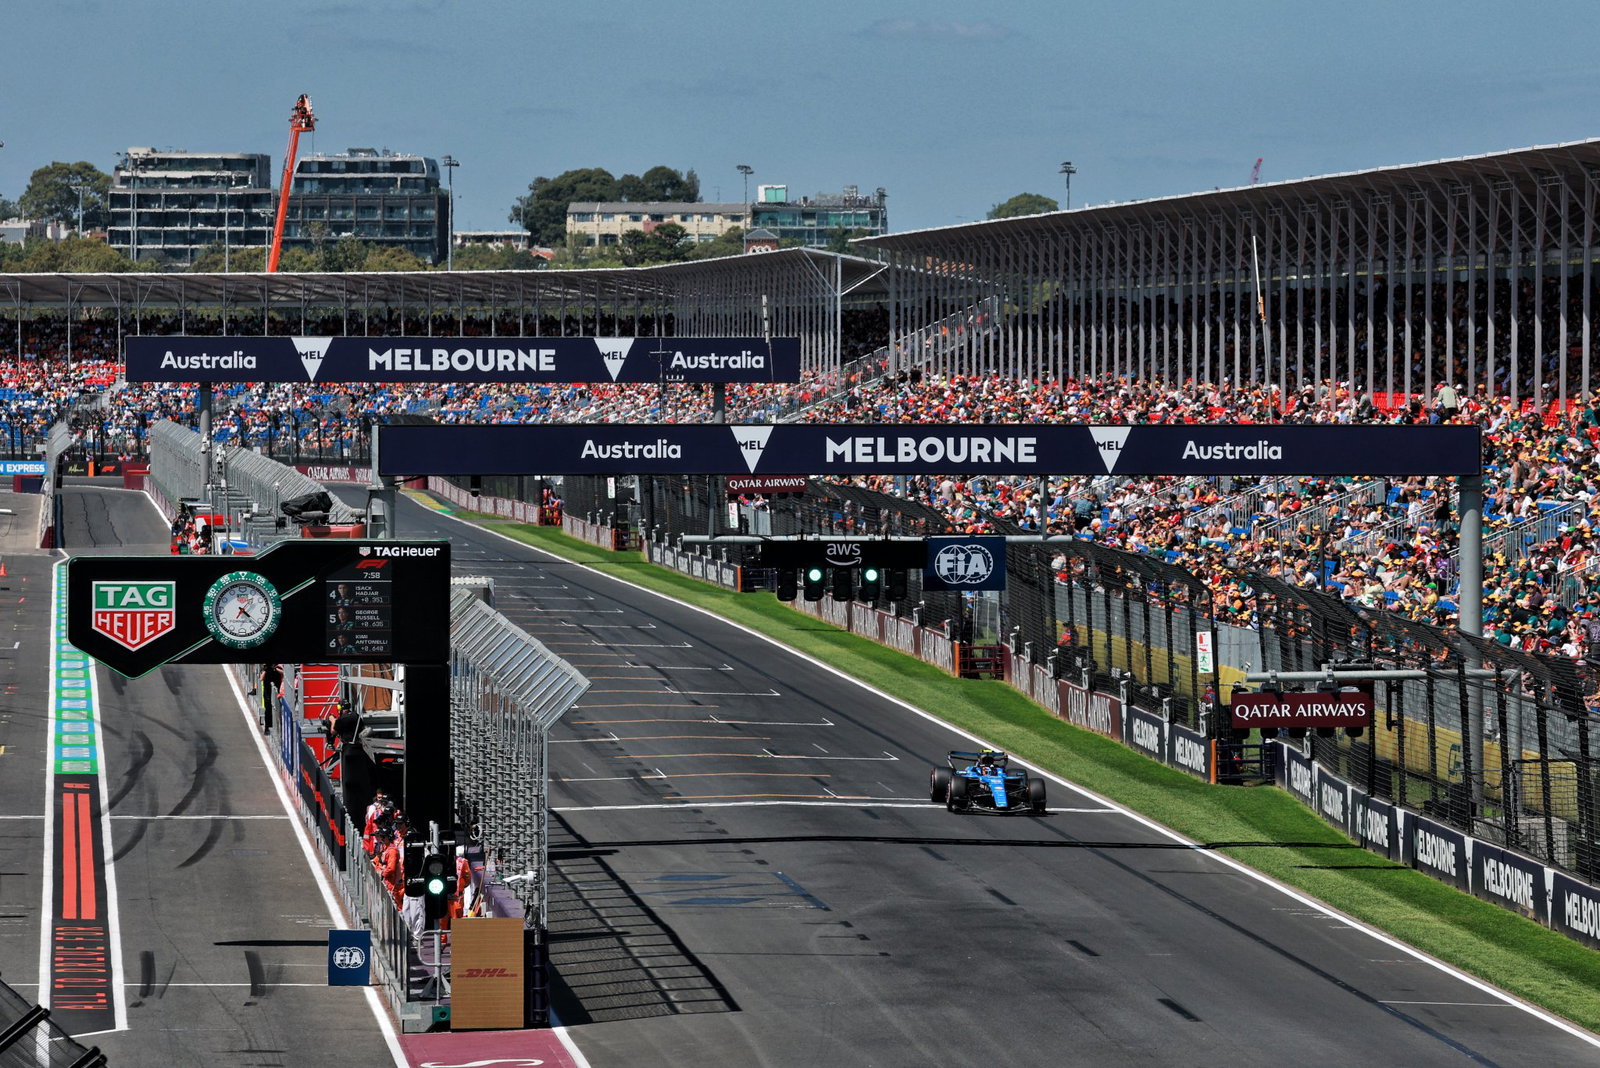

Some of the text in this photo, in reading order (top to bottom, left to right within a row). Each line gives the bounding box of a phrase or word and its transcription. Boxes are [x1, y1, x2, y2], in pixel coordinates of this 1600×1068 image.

[160, 350, 257, 369] Australia
[299, 350, 325, 360] MEL
[368, 347, 556, 371] MELBOURNE
[601, 351, 626, 360] MEL
[670, 350, 764, 369] Australia
[581, 439, 682, 459] Australia
[738, 440, 765, 450] MEL
[826, 436, 1037, 463] MELBOURNE
[1096, 440, 1123, 451] MEL
[1182, 440, 1283, 460] Australia
[6, 464, 45, 472] EXPRESS
[729, 478, 806, 490] QATAR AIRWAYS
[827, 543, 861, 556] aws
[99, 586, 168, 607] TAG
[329, 590, 336, 599] 4
[329, 614, 336, 623] 5
[97, 613, 170, 645] HEUER
[329, 639, 336, 648] 6
[1235, 703, 1366, 720] QATAR AIRWAYS
[1132, 717, 1159, 754] MELBOURNE
[1175, 735, 1206, 774] MELBOURNE
[1413, 827, 1456, 877] MELBOURNE
[1483, 856, 1534, 909] MELBOURNE
[464, 968, 509, 978] DHL
